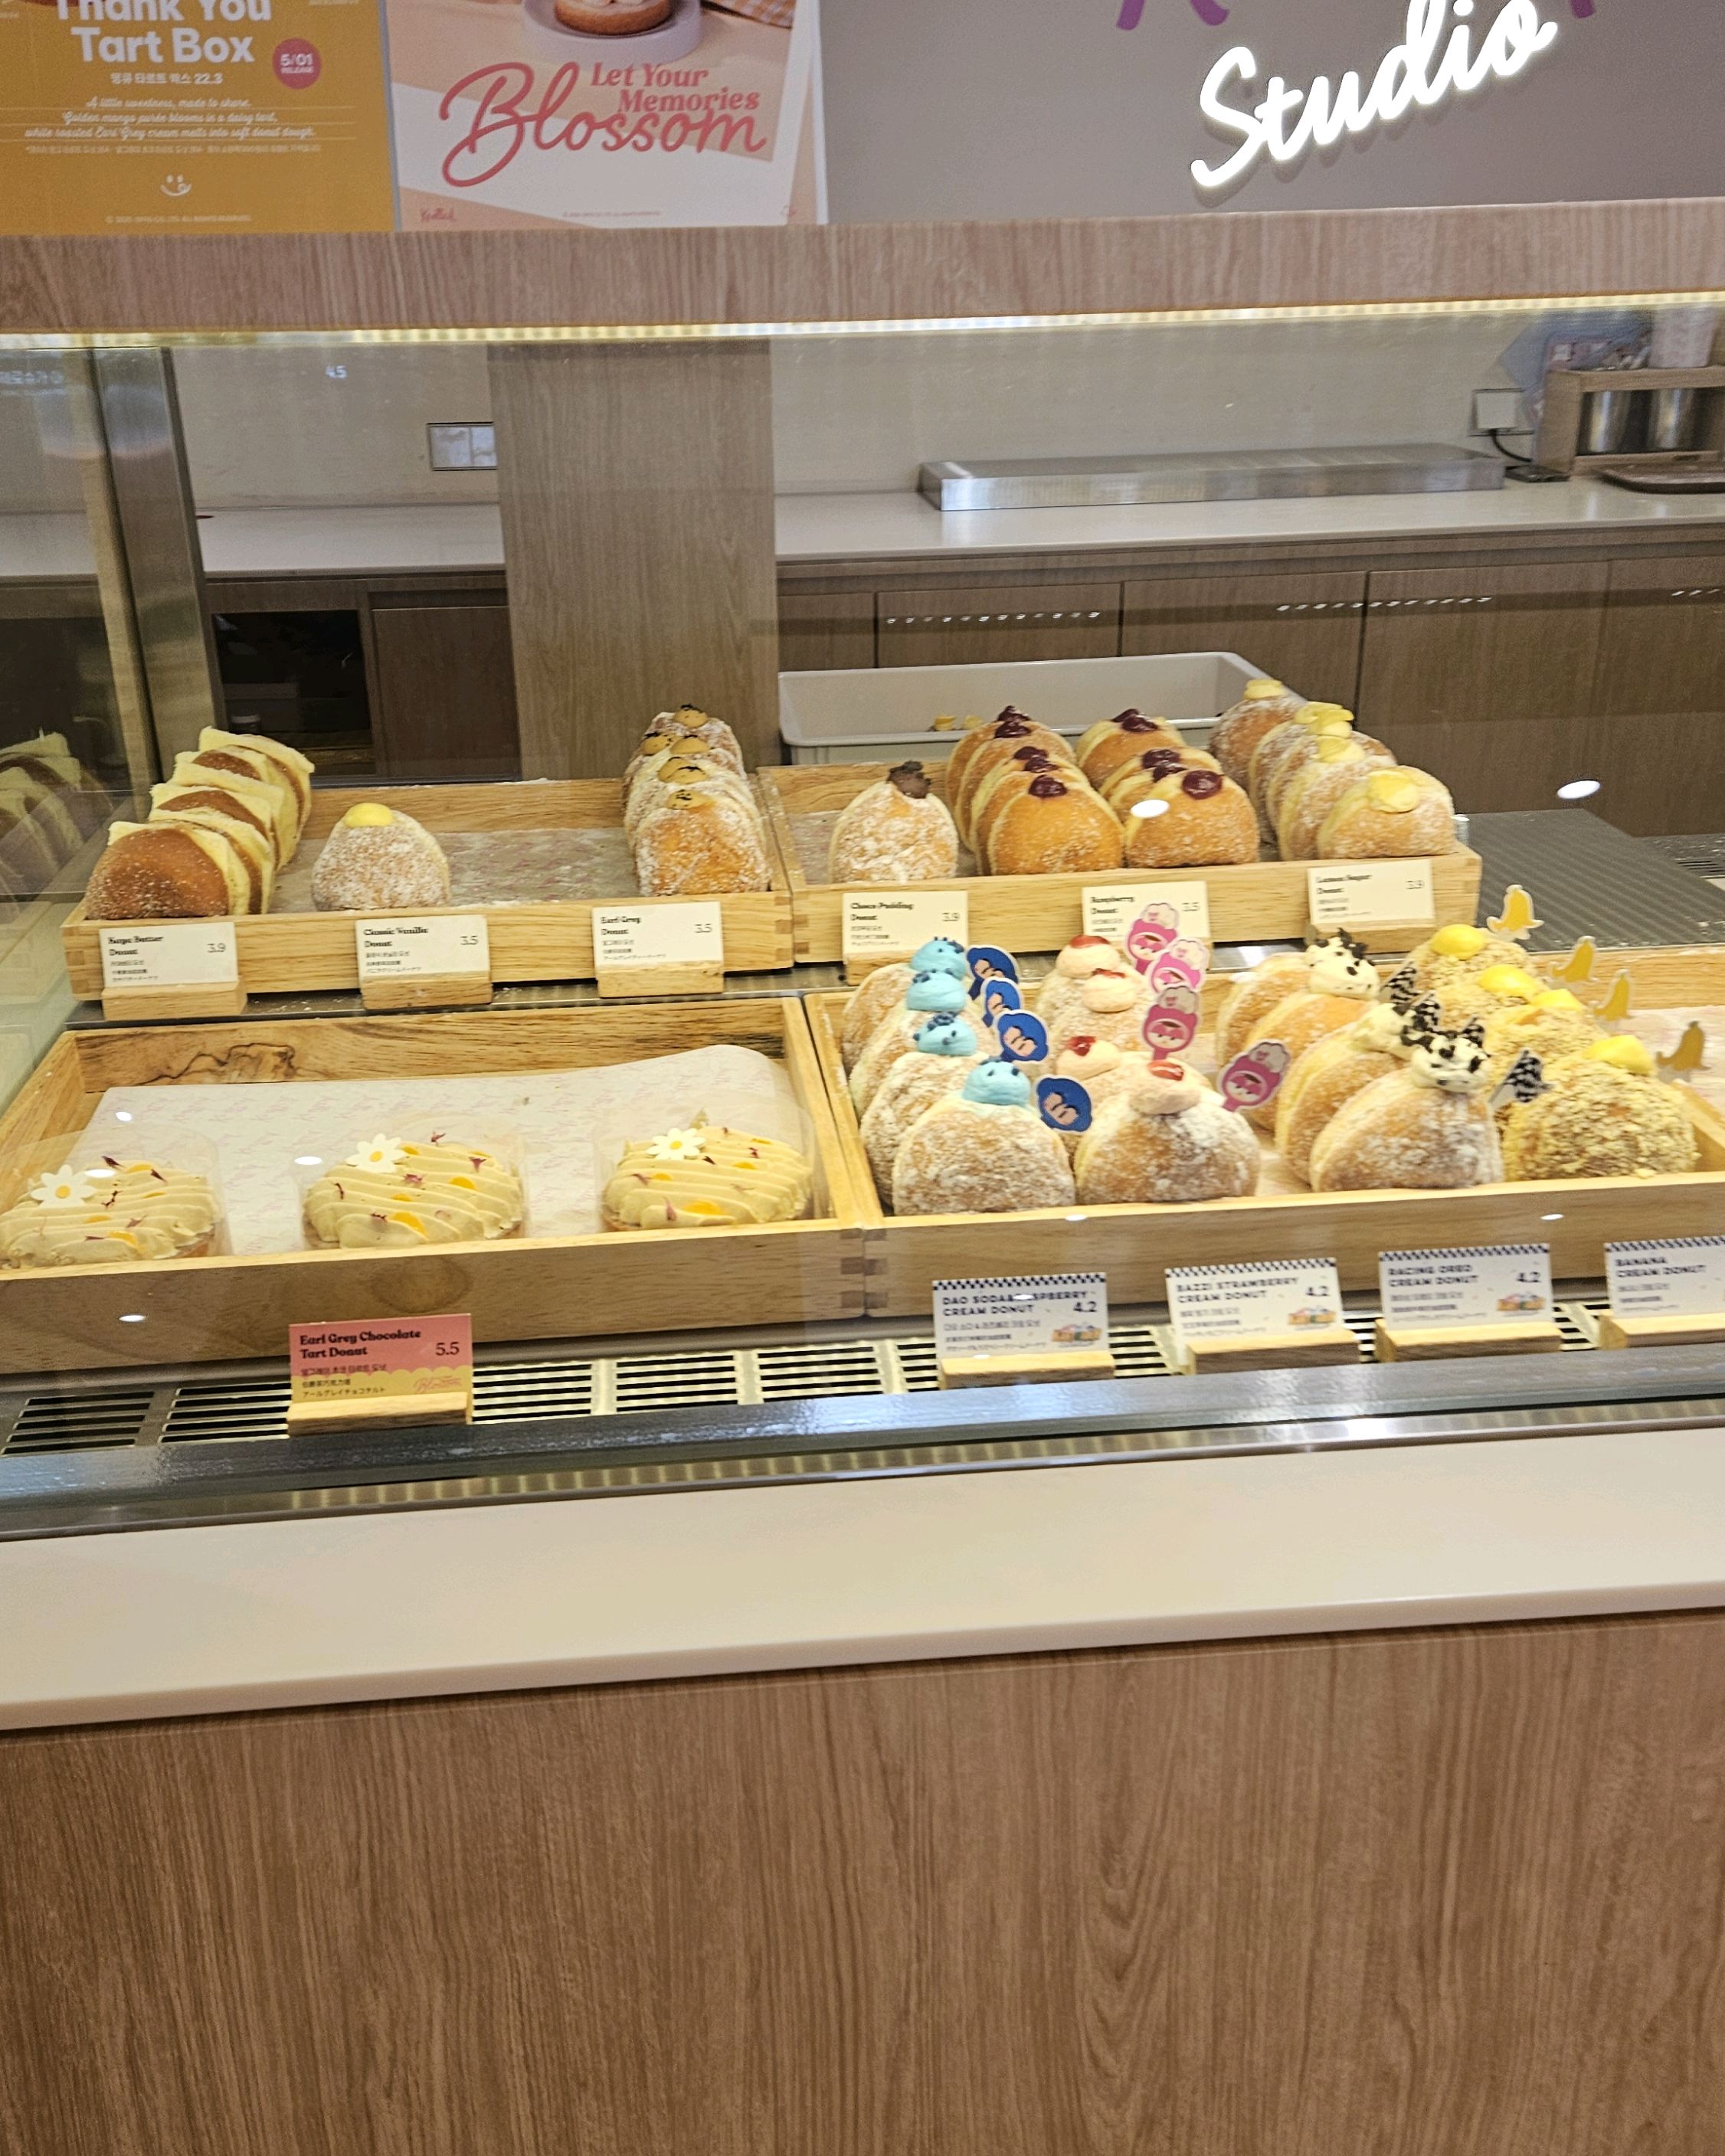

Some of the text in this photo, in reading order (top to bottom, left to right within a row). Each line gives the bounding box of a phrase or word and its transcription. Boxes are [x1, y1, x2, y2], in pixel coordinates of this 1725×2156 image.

[199, 0, 271, 21] You
[71, 27, 254, 63] Tart Box
[591, 62, 709, 88] Let Your
[617, 87, 760, 113] Memories
[1190, 0, 1558, 187] Studio
[439, 61, 767, 187] Blossom
[1216, 1277, 1298, 1290] STRAWBERRY
[1388, 1274, 1479, 1287] CREAM DONUT
[1177, 1289, 1267, 1304] CREAM DONUT
[1305, 1285, 1331, 1297] 4.2
[942, 1304, 1033, 1317] CREAM DONUT
[1073, 1300, 1098, 1313] 4.2
[300, 1329, 422, 1346] Earl Grey Chocolate
[300, 1346, 368, 1359] Tart Donut
[435, 1342, 460, 1356] 5.5
